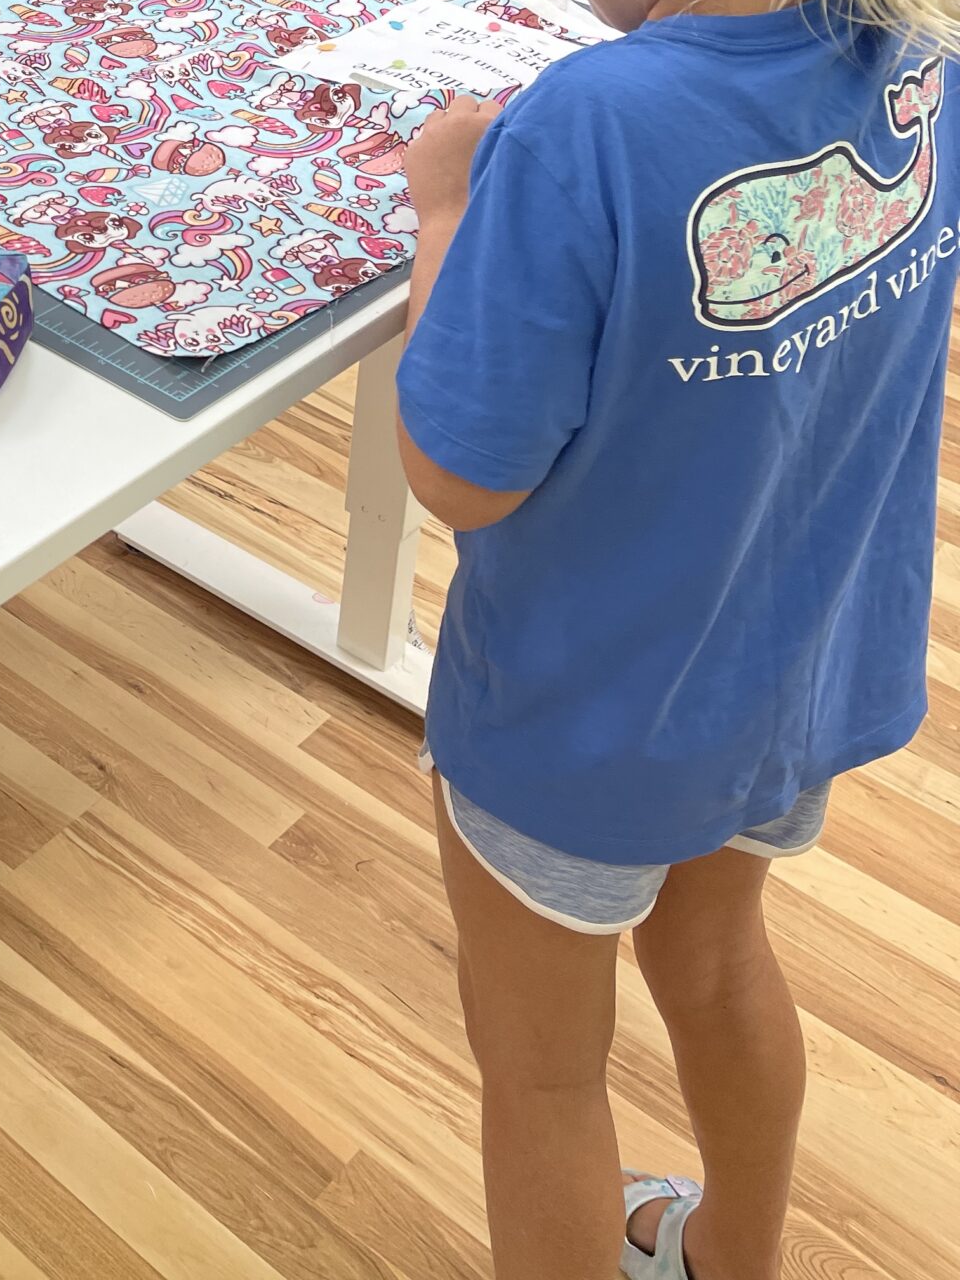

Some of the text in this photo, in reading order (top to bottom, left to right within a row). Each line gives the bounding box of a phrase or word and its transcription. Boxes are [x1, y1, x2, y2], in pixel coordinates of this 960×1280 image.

[424, 29, 440, 37] 2
[435, 21, 452, 29] 2
[453, 25, 491, 40] Cut
[442, 34, 480, 46] Cut
[352, 62, 430, 89] Square
[432, 49, 522, 85] Grain Line
[408, 65, 472, 91] illow
[668, 216, 960, 383] vineyard vine
